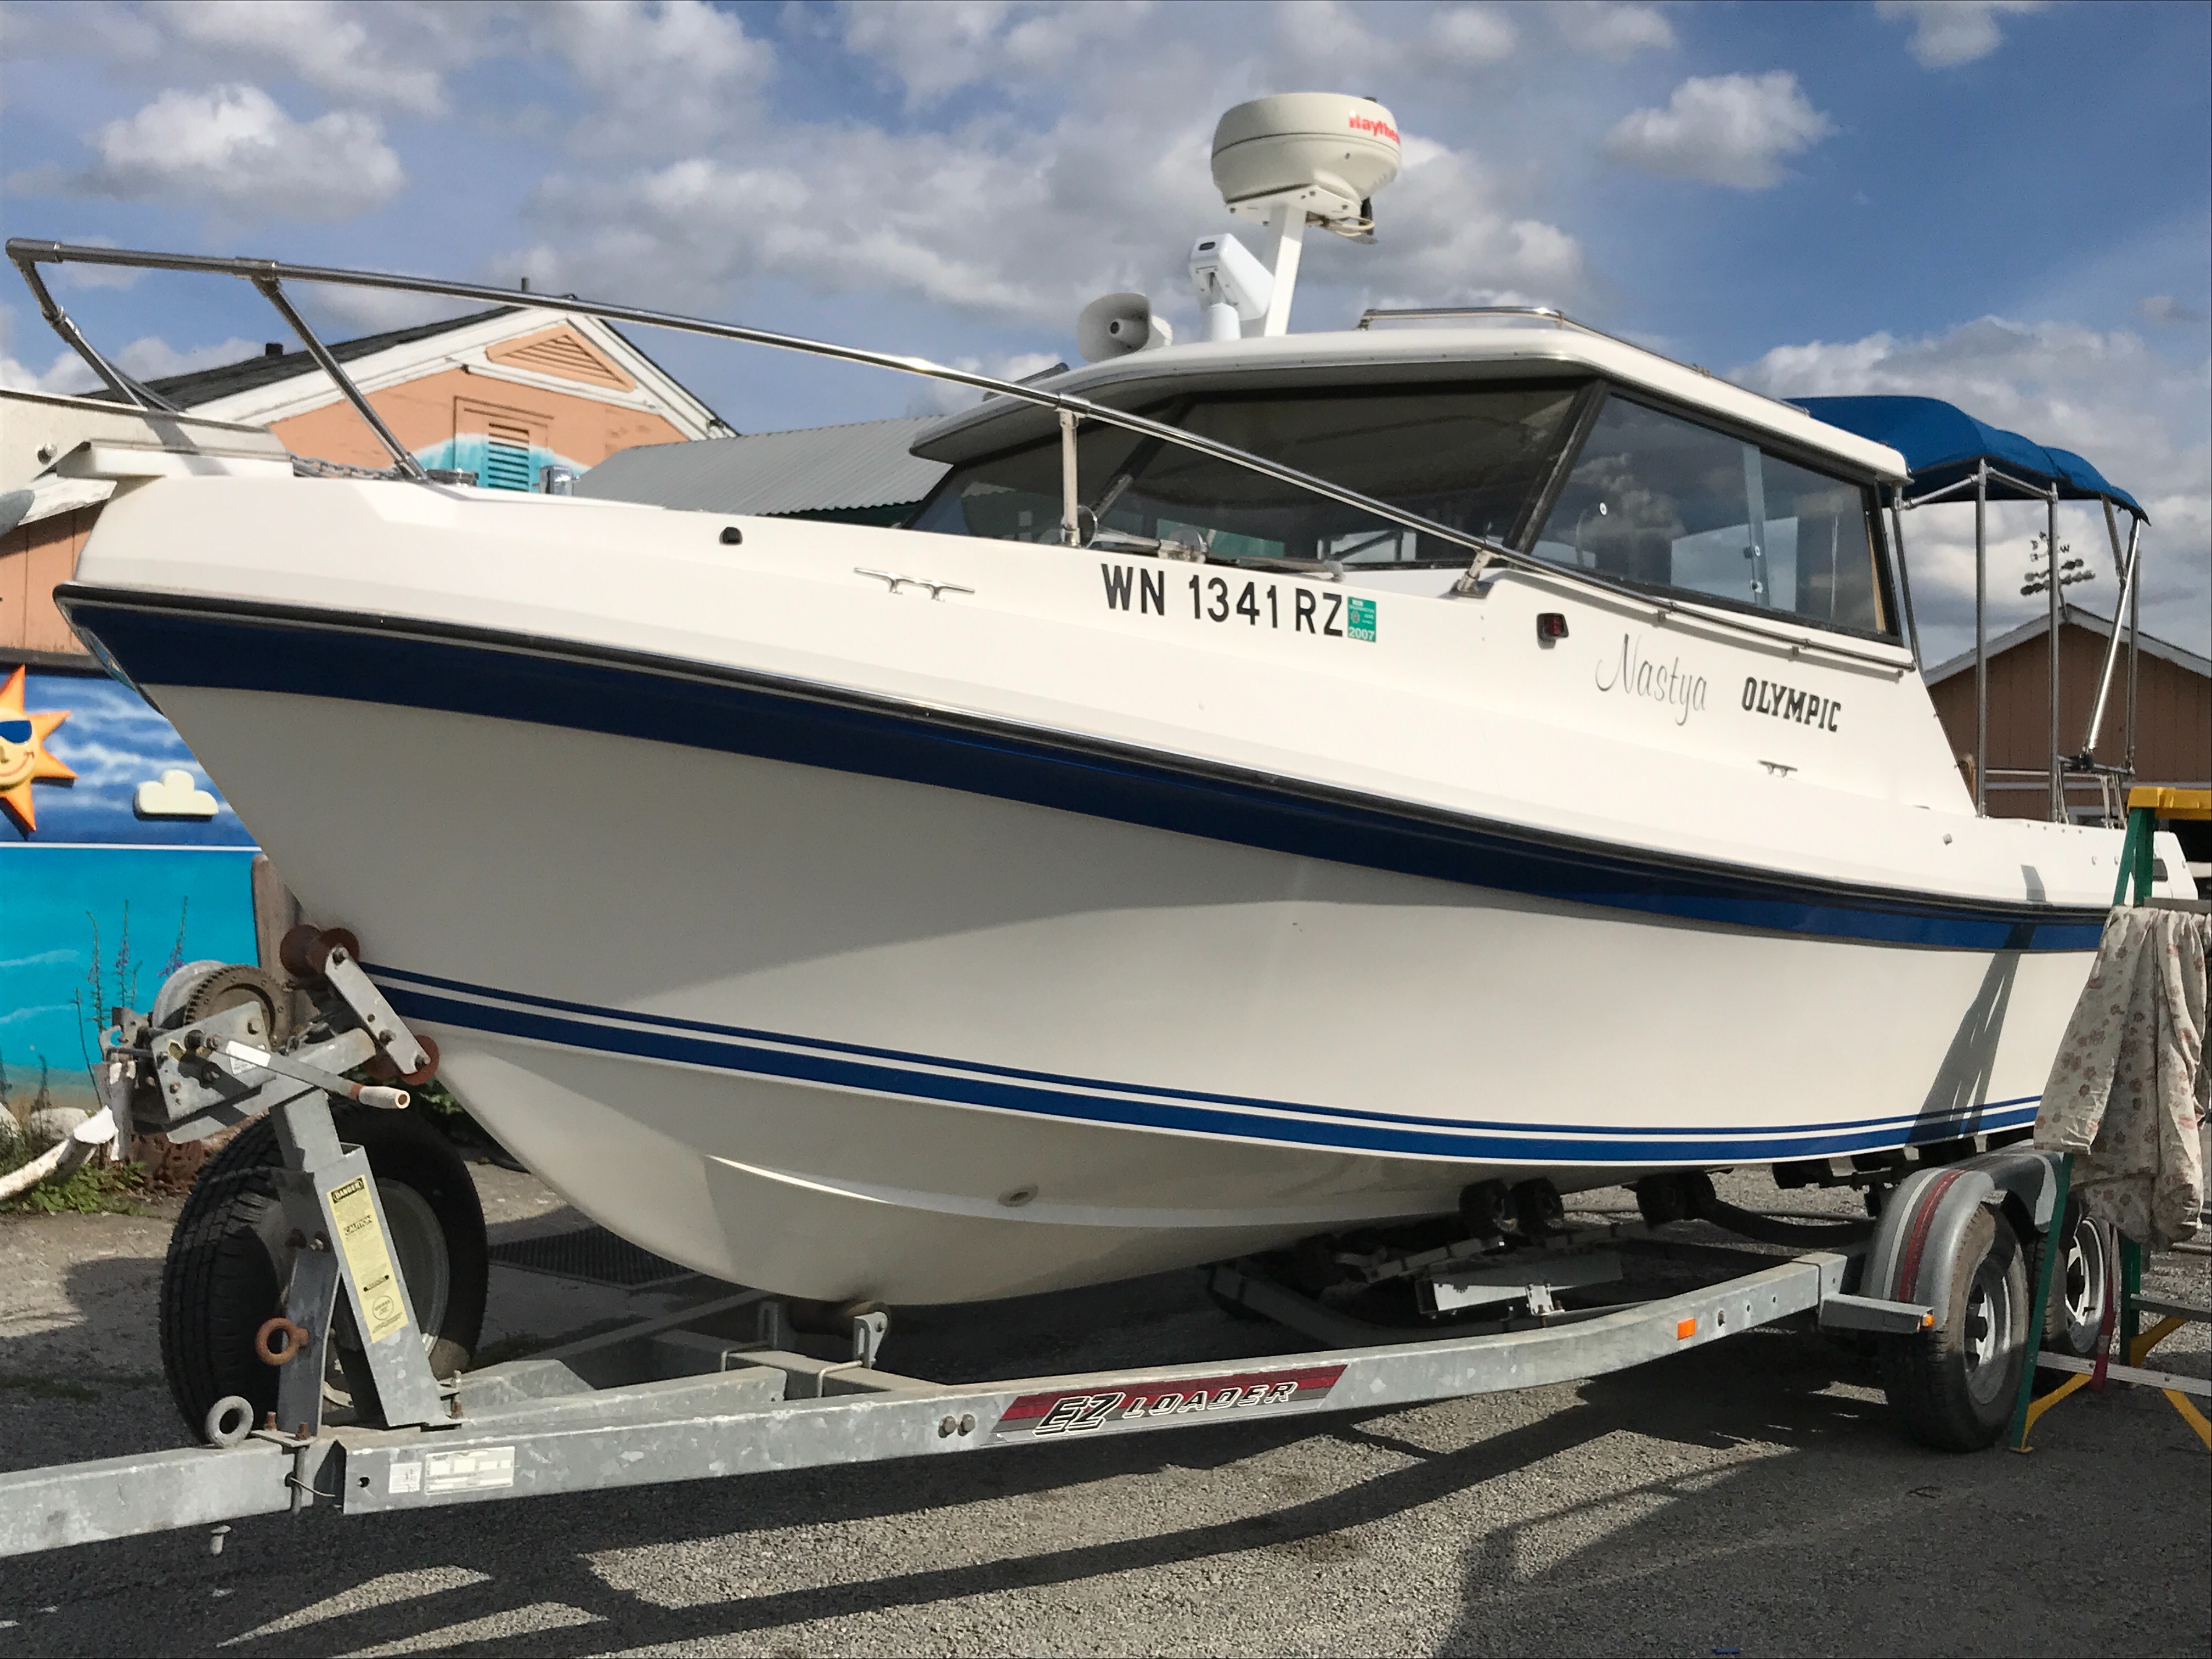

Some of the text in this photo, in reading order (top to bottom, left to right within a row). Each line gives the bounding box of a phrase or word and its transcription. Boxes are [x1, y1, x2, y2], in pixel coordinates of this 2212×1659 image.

[1101, 563, 1342, 636] WN 1341 RZ
[1349, 626, 1374, 641] 2007
[1595, 633, 1707, 726] Nastya
[1742, 676, 1842, 732] OLYMPIC
[1032, 1381, 1298, 1436] EZ LOADER
